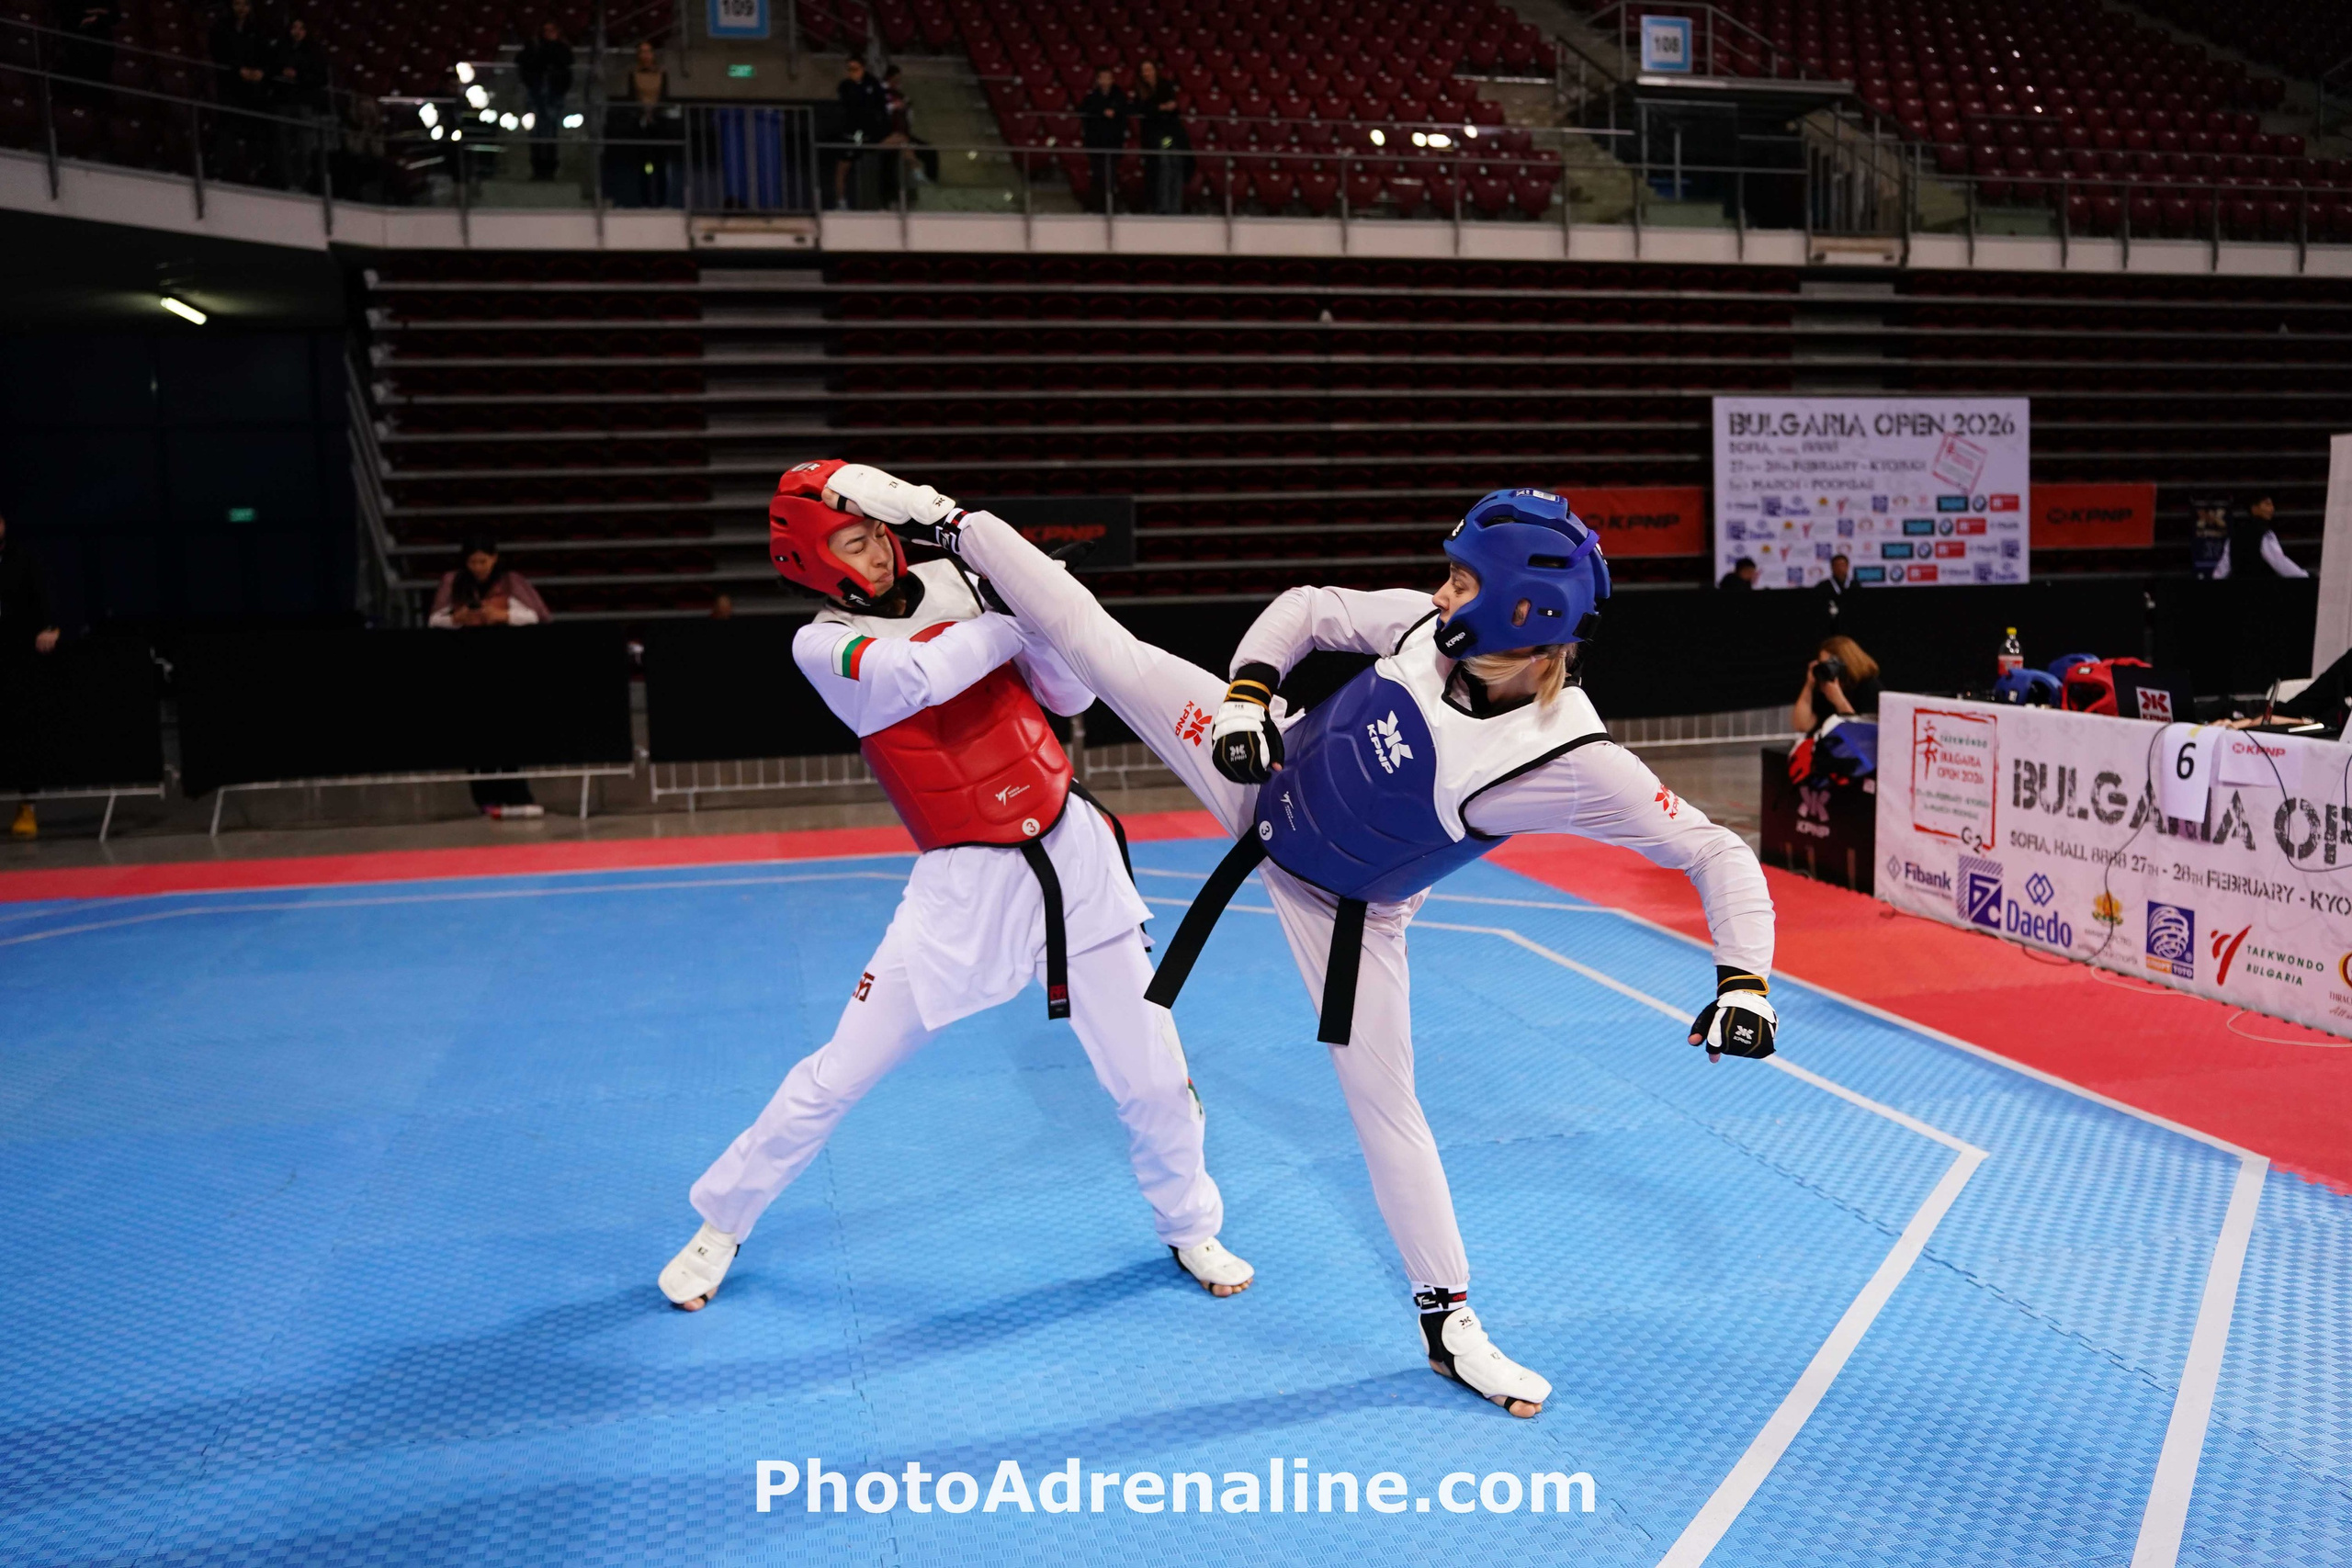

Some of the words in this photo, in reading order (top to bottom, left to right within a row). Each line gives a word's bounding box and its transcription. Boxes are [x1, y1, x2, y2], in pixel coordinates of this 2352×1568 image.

[1655, 36, 1679, 53] 108
[1728, 412, 1867, 437] BULGARIA
[1874, 412, 1945, 436] OPEN
[1953, 412, 2015, 436] 2026
[1609, 514, 1679, 529] KPNP
[2070, 508, 2132, 524] KPNP
[1445, 632, 1466, 649] KPNP
[1175, 700, 1194, 736] KPNP
[1367, 724, 1394, 774] KPNP
[2177, 742, 2196, 780] 6
[2245, 744, 2287, 758] KPNP
[1796, 819, 1830, 839] KPNP
[1905, 862, 1951, 890] Fibank
[2010, 829, 2051, 855] SOFIA,
[2132, 854, 2159, 876] 27TH
[2173, 863, 2204, 886] 28TH
[2207, 869, 2295, 904] FEBRUARY
[2007, 898, 2072, 949] Daedo
[2247, 943, 2324, 972] TAEKWONDO
[2246, 963, 2303, 987] BULGARIA
